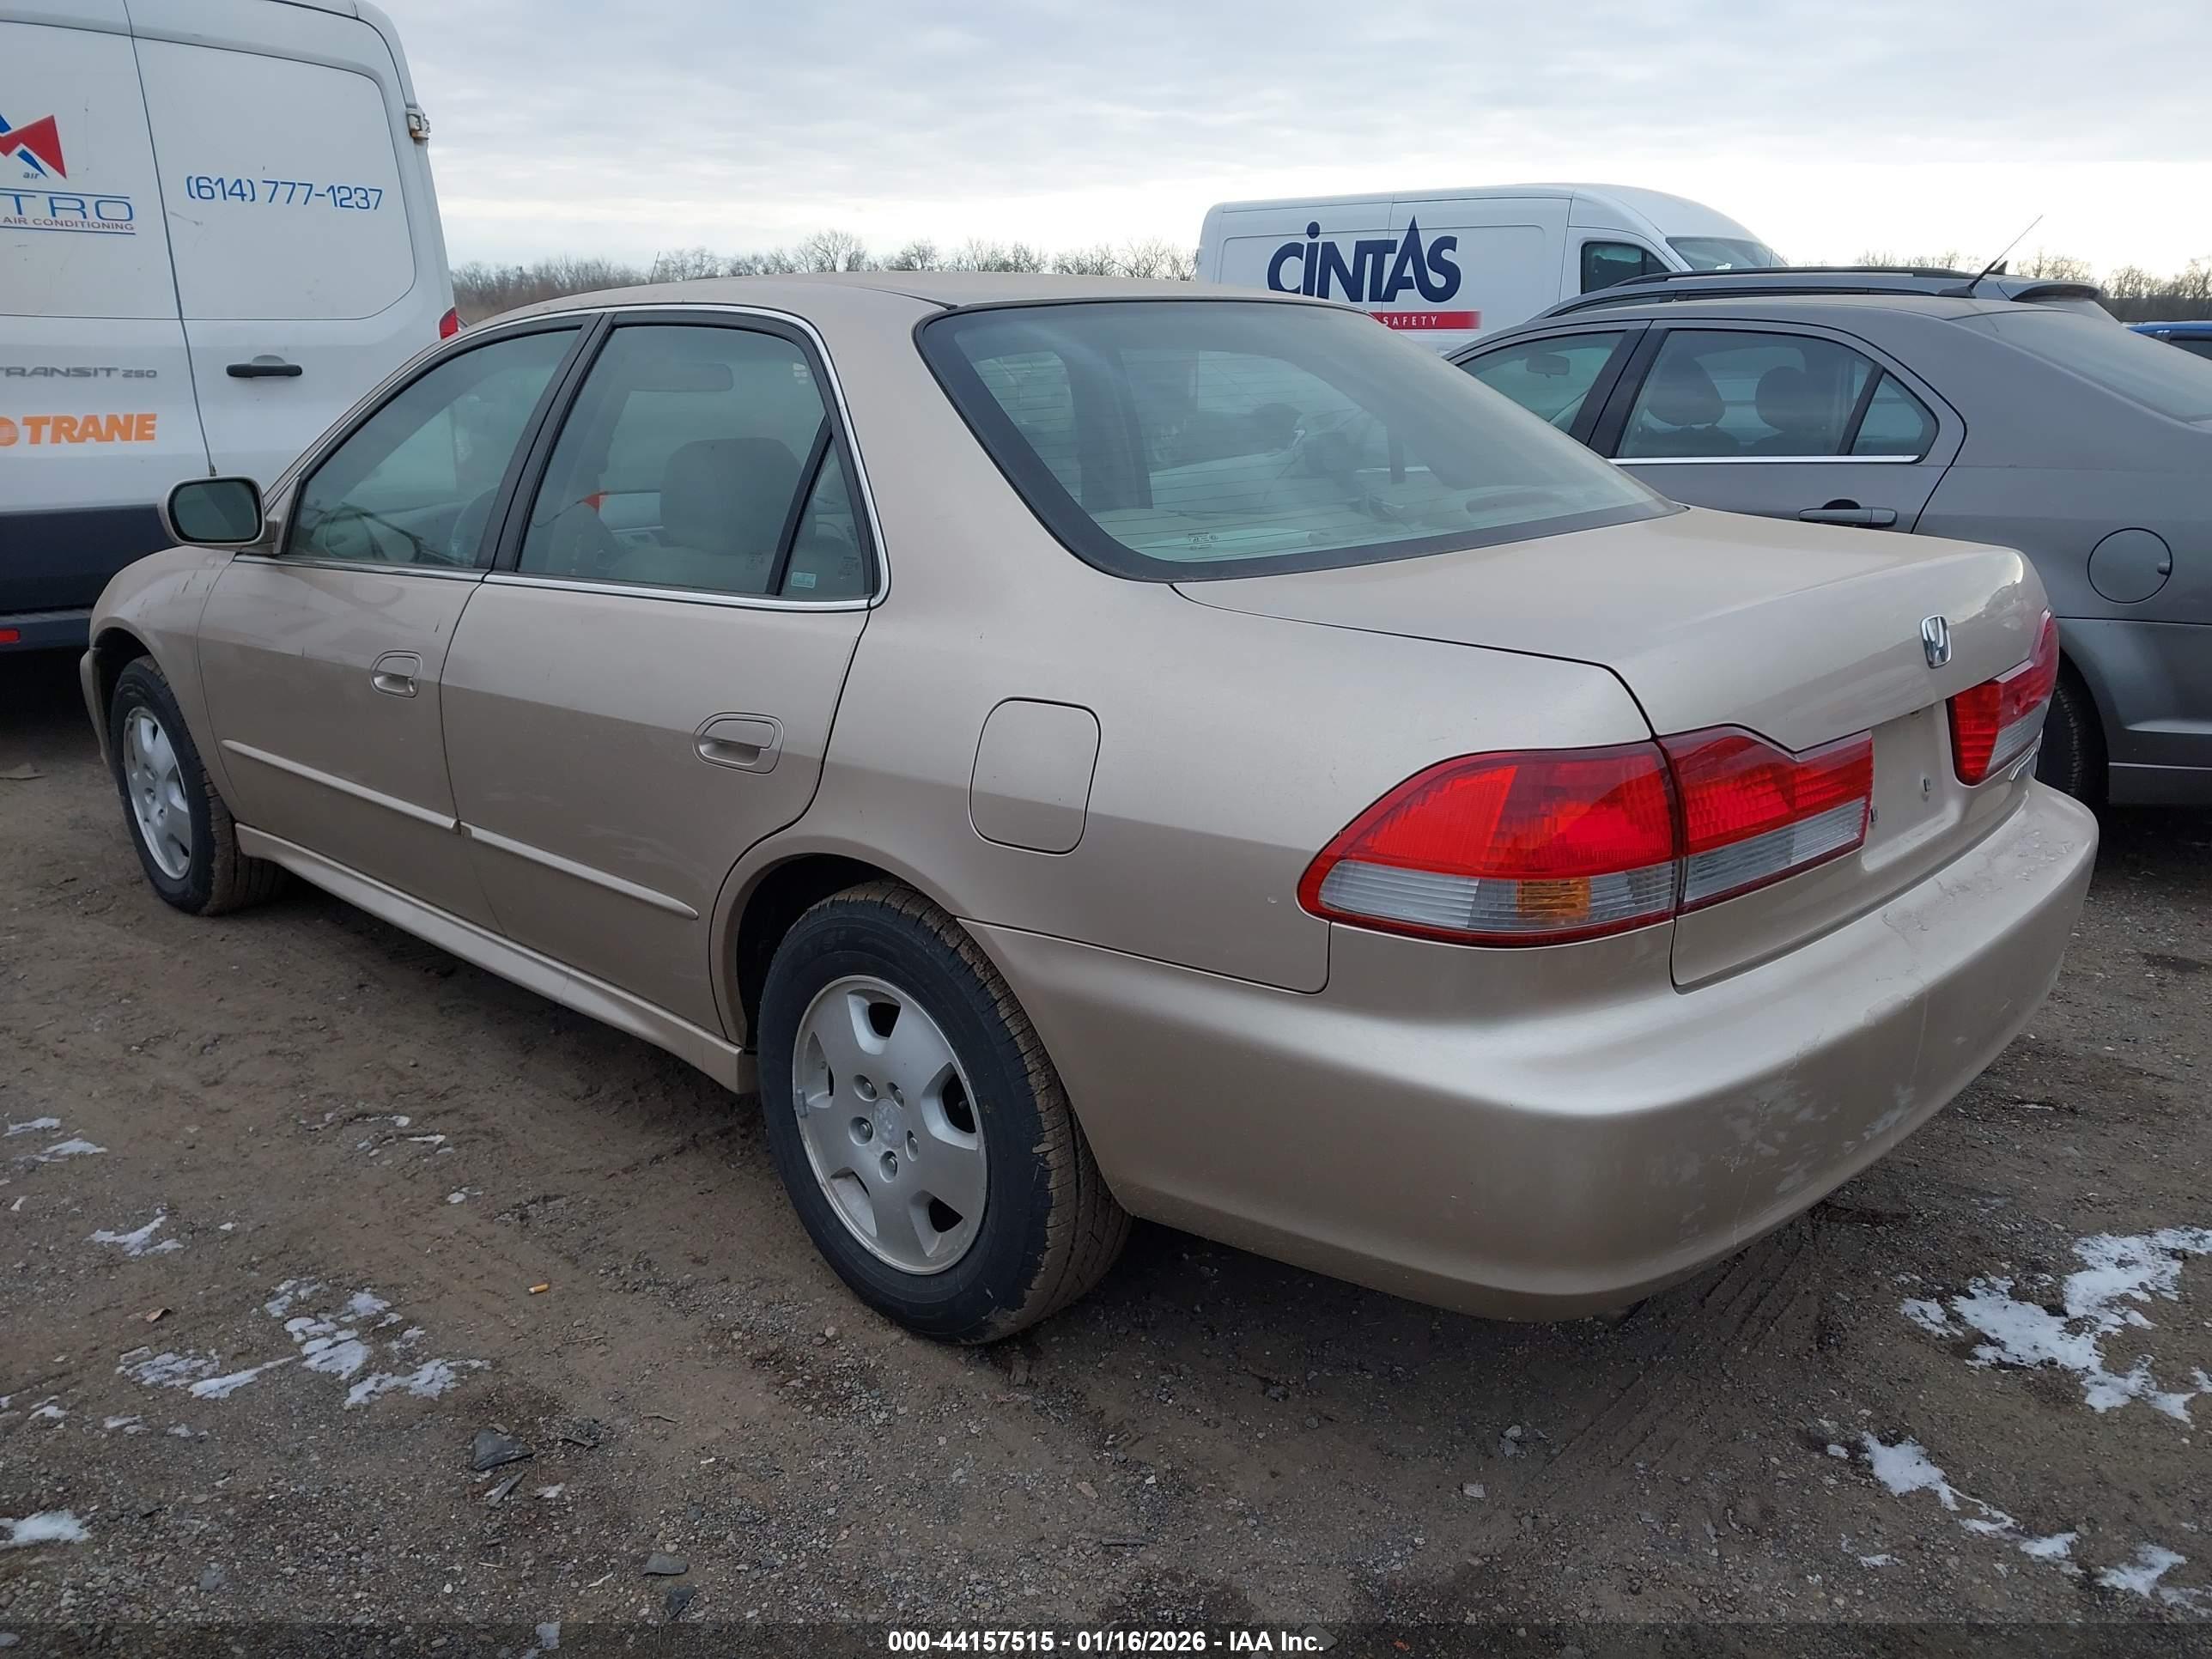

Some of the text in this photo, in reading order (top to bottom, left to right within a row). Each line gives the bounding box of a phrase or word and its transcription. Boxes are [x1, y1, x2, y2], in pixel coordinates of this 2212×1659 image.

[186, 175, 383, 210] (614) 777-1237
[3, 216, 134, 231] AIR CONDITIONING
[1382, 314, 1438, 326] SAFETY
[122, 369, 158, 379] 250
[21, 413, 157, 445] TRANE
